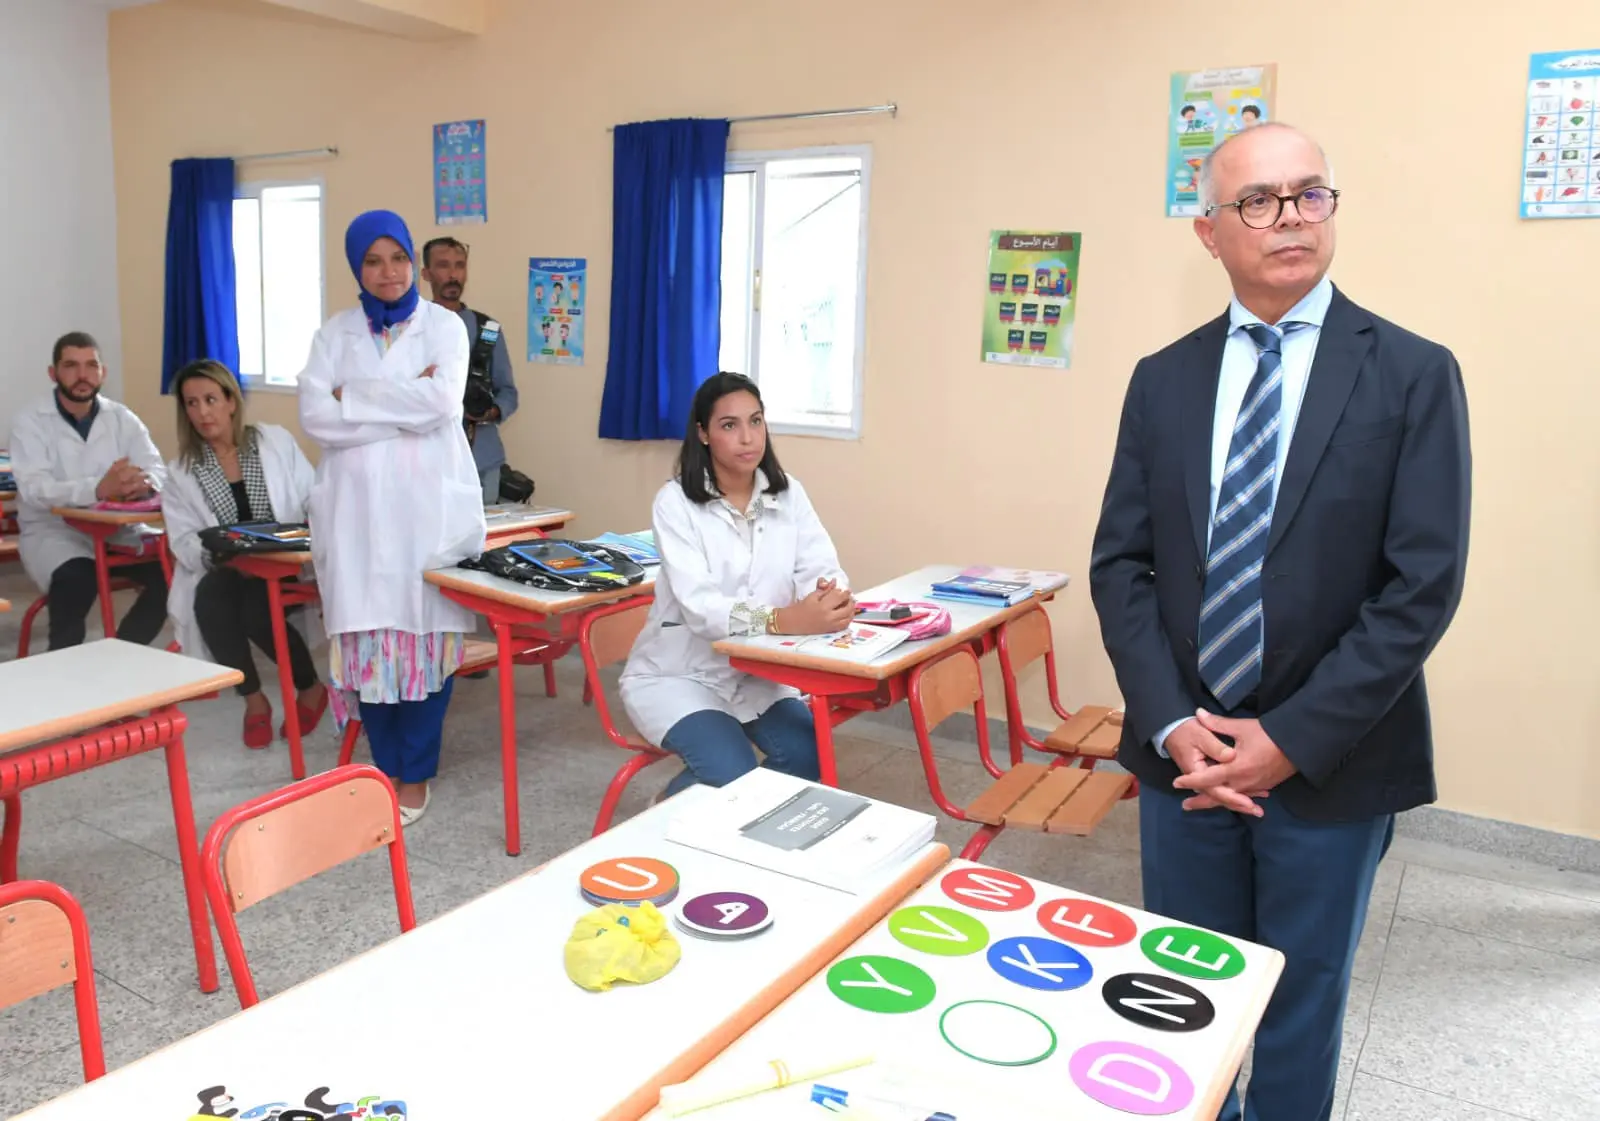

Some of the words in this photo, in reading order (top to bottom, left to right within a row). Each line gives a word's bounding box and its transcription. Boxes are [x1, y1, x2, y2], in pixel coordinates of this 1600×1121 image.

[1013, 236, 1040, 248] الأسبوع
[1043, 237, 1059, 248] أيام
[592, 862, 659, 892] U
[954, 873, 1022, 906] M
[712, 901, 751, 924] A
[900, 910, 967, 942] V
[1051, 905, 1114, 939] F
[1001, 943, 1080, 983] K
[1155, 935, 1230, 971] E
[840, 962, 913, 997] Y
[1119, 979, 1197, 1024] N
[1087, 1053, 1172, 1102] D
